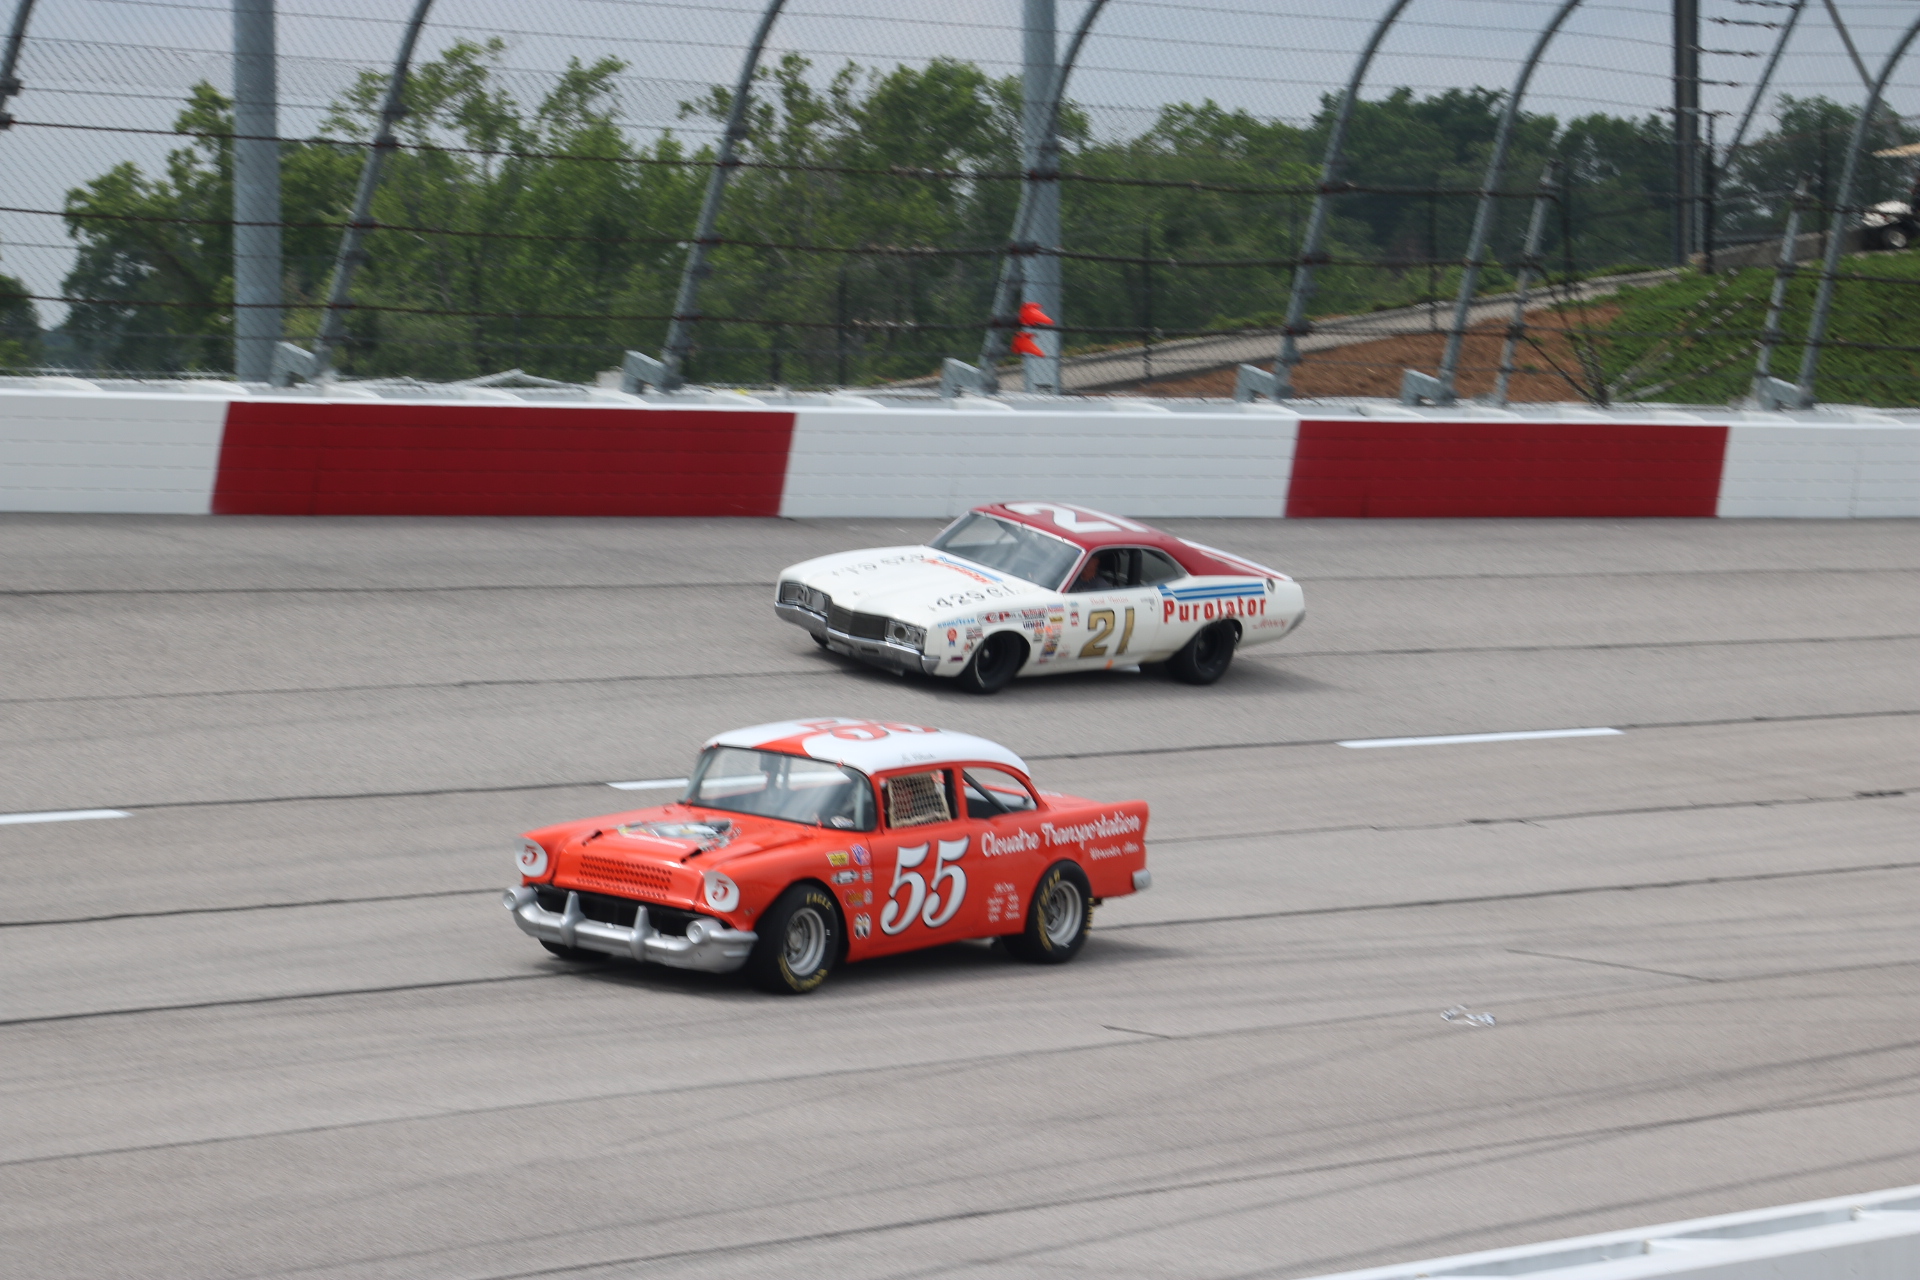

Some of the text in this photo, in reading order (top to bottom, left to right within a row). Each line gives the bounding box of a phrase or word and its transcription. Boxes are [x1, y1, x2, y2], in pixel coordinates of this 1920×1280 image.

[1003, 501, 1150, 534] 21
[1162, 595, 1267, 624] Purolator
[1078, 606, 1136, 659] 21
[1040, 811, 1142, 850] Transportation
[520, 844, 540, 867] 5
[711, 878, 730, 901] 5
[879, 834, 971, 936] 55
[806, 892, 833, 910] EAGLE
